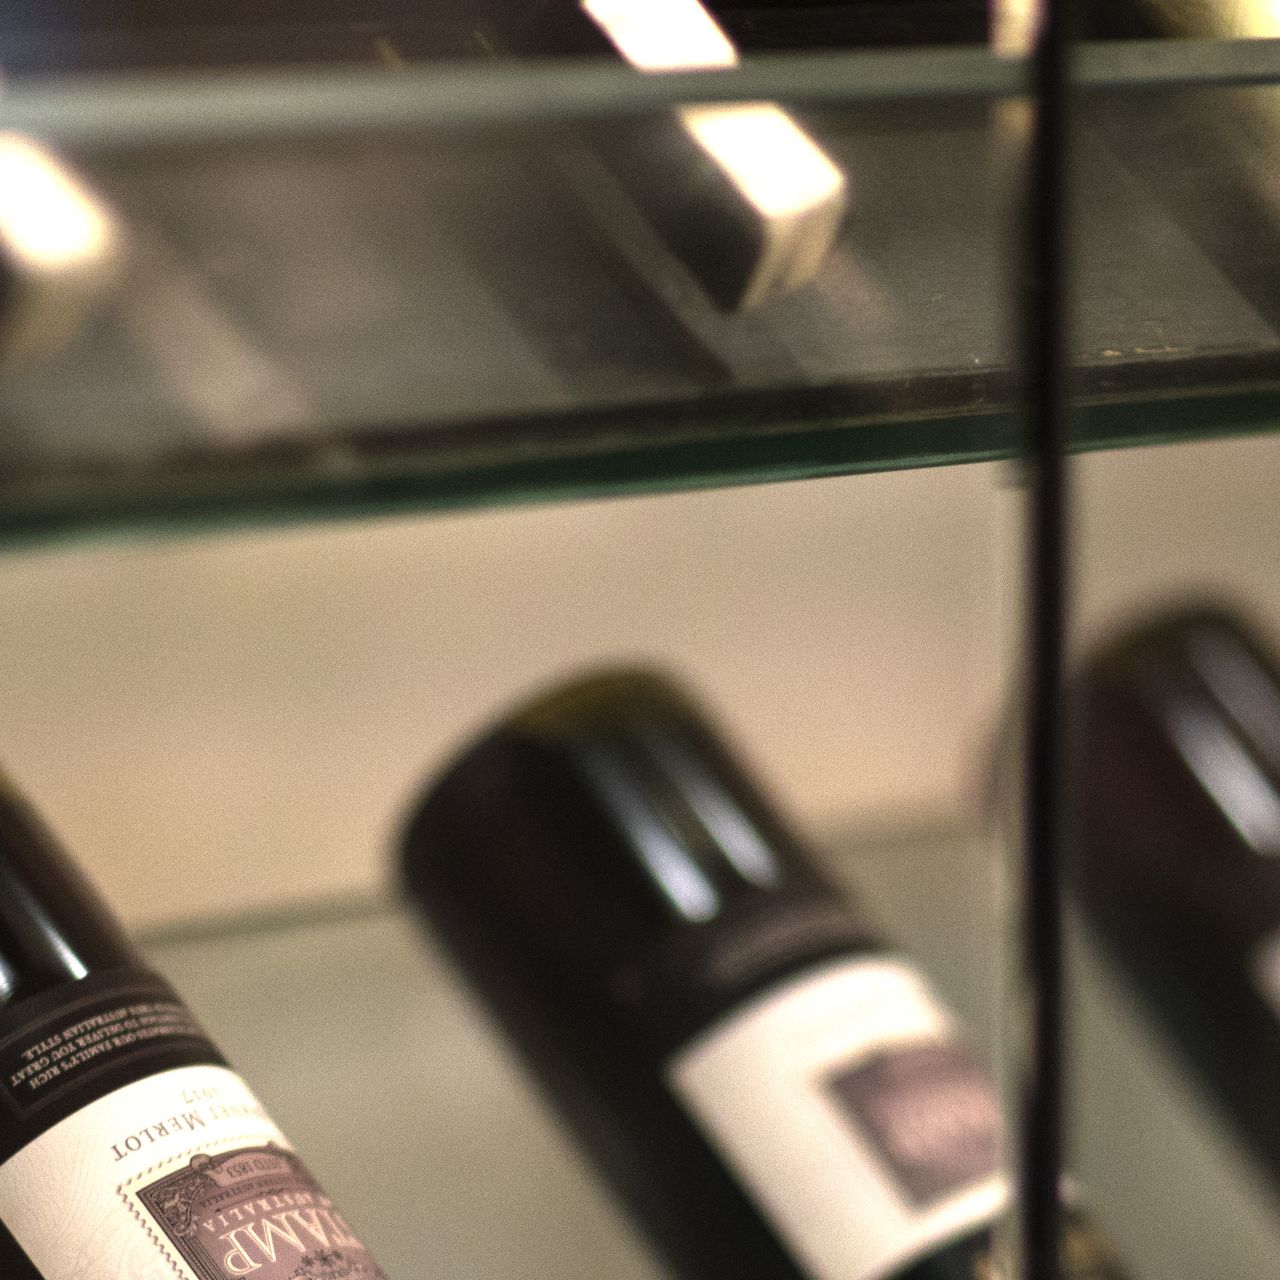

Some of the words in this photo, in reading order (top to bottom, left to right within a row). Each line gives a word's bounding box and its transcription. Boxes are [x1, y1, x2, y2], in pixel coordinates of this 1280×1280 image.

[76, 1022, 122, 1047] DELIVER
[50, 1040, 76, 1063] YOU
[60, 1040, 111, 1071] FAMILY'S
[10, 1056, 49, 1087] GREAT
[28, 1065, 60, 1090] RICH
[219, 1209, 363, 1275] TAMP
